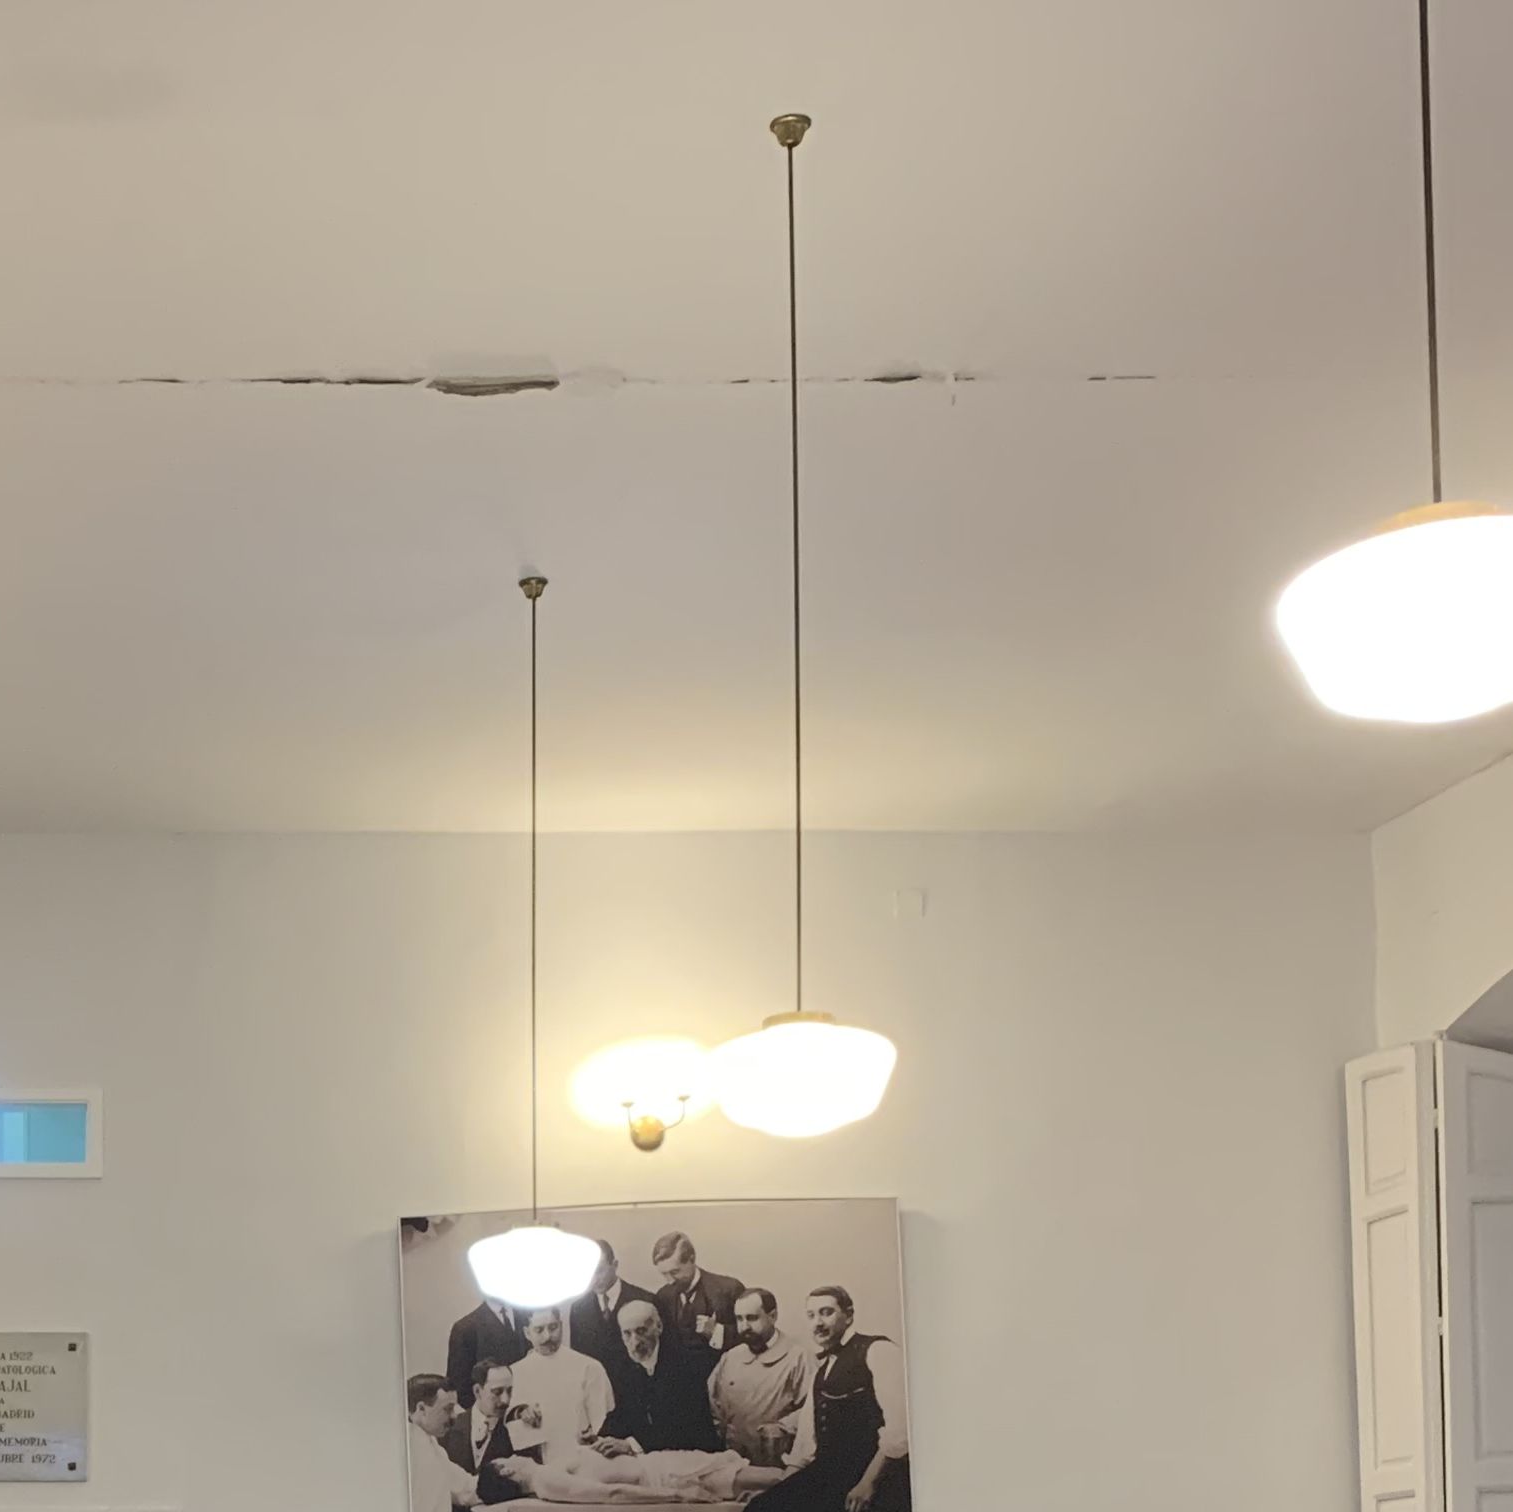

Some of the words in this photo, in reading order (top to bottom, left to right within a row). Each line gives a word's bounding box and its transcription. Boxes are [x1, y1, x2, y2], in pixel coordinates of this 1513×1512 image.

[0, 1351, 7, 1361] A
[9, 1351, 34, 1361] 1922
[30, 1453, 57, 1465] 1972
